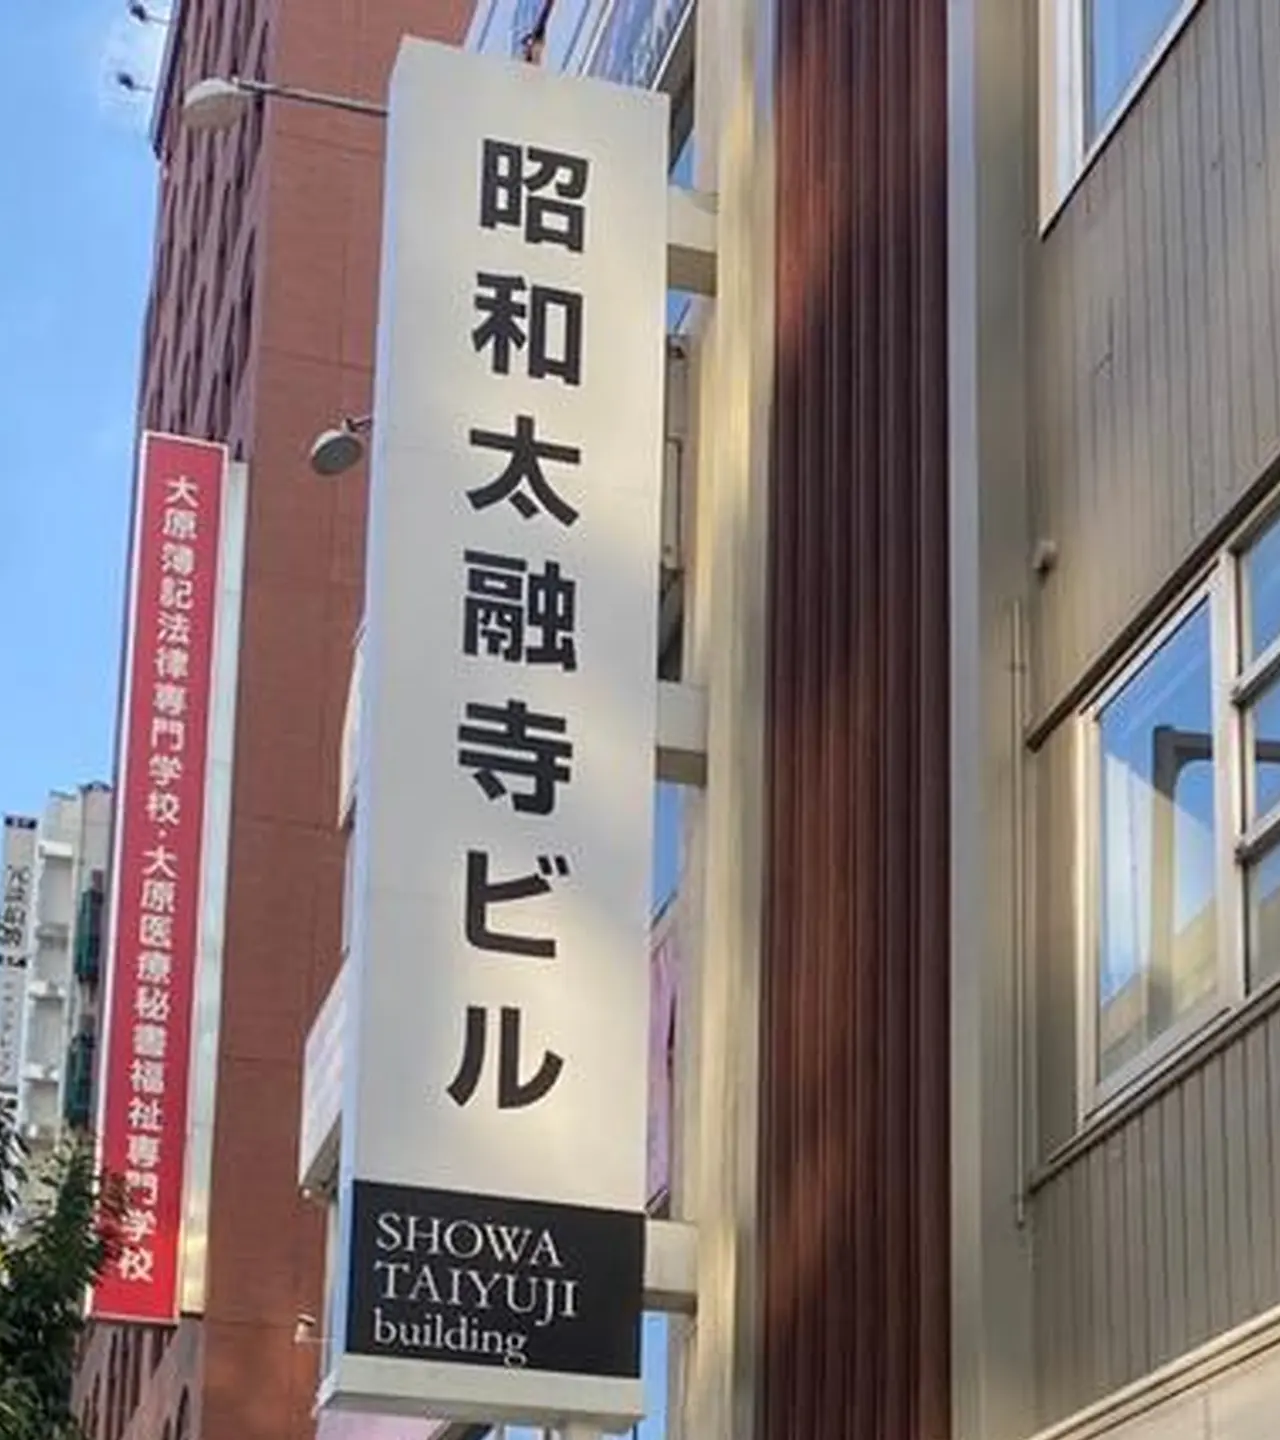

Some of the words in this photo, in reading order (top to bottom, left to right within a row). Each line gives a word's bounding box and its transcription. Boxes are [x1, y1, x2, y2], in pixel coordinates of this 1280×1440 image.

[446, 138, 591, 1110] 昭和太融寺ビル
[375, 1212, 563, 1268] SHOWA
[373, 1260, 579, 1326] TAIYUJI
[373, 1307, 528, 1367] building
